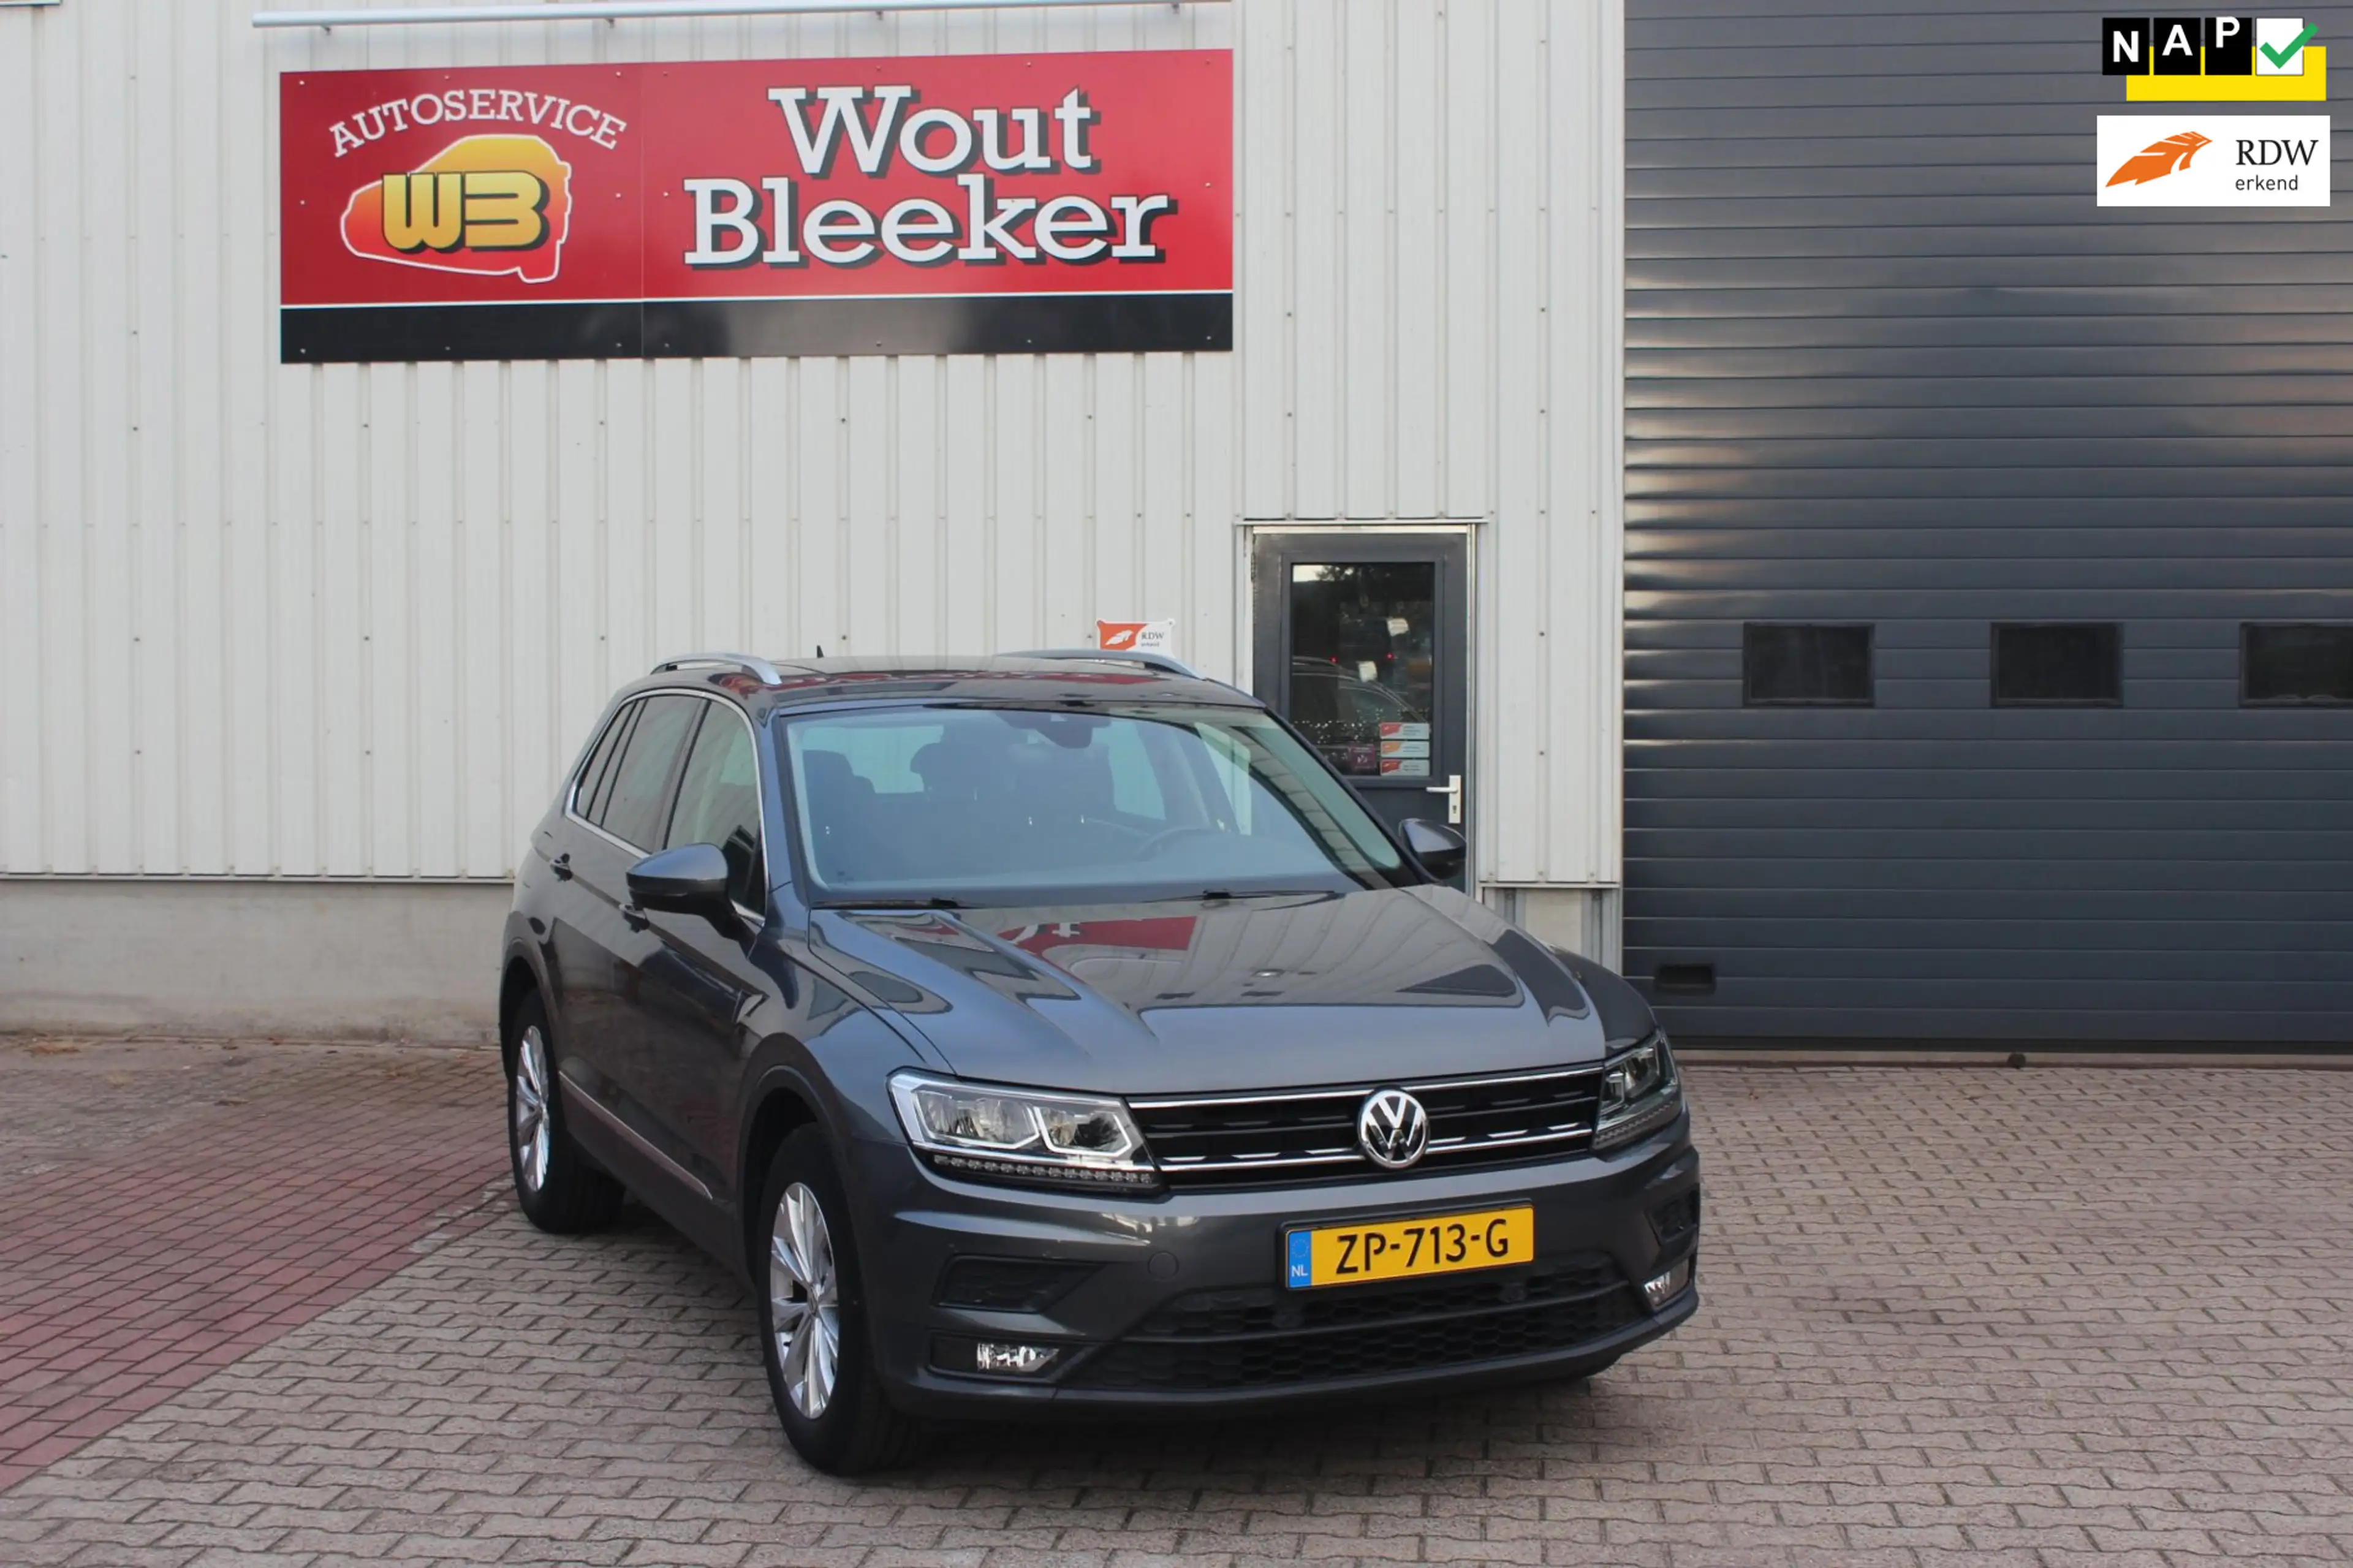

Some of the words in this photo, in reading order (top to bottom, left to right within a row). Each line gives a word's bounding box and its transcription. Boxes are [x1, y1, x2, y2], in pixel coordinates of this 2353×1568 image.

[329, 89, 627, 157] AUTOSERVICE
[767, 85, 1097, 176] Wout
[683, 173, 1173, 267] Bleeker
[1291, 1264, 1308, 1278] NL
[1335, 1218, 1509, 1275] ZP-713-G
